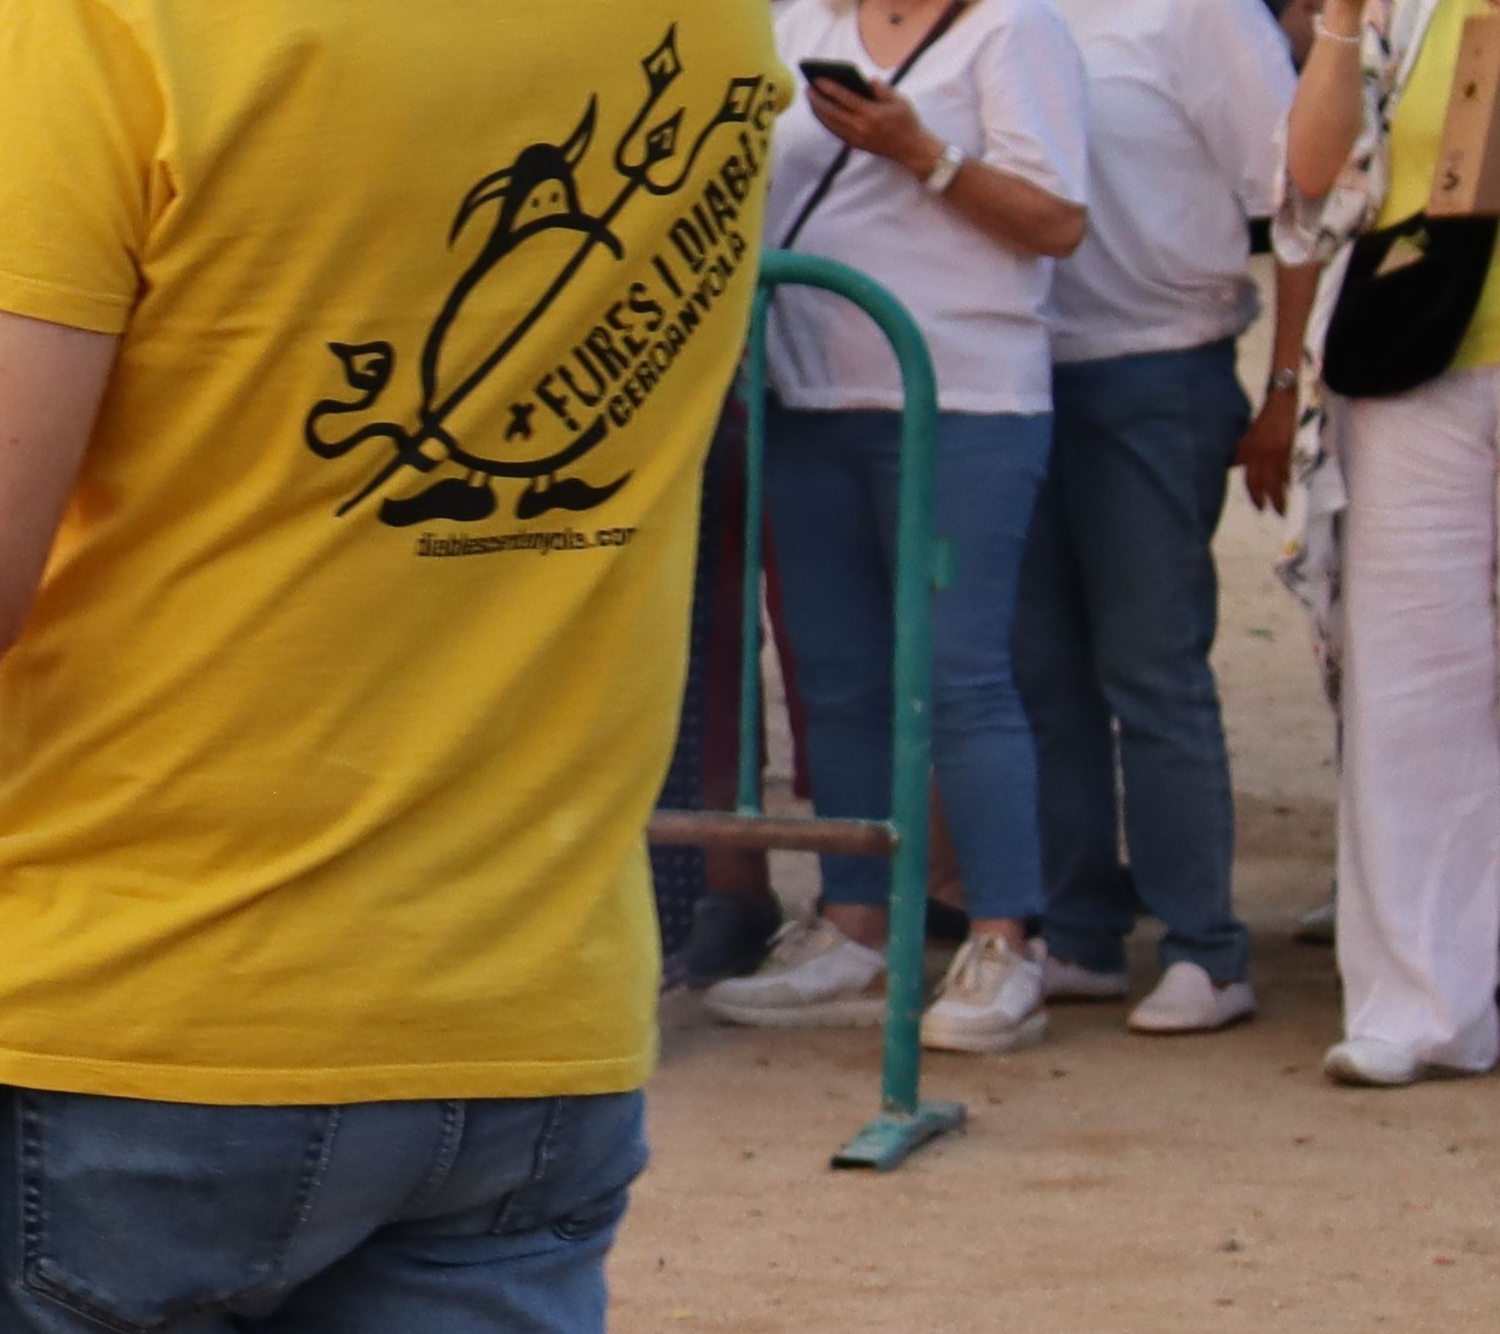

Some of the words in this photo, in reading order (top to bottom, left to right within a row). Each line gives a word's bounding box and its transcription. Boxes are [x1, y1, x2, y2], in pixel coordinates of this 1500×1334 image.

[534, 281, 664, 432] FURES
[652, 254, 684, 299] I
[669, 81, 776, 275] DIABL
[607, 233, 747, 429] CERDANYOLA
